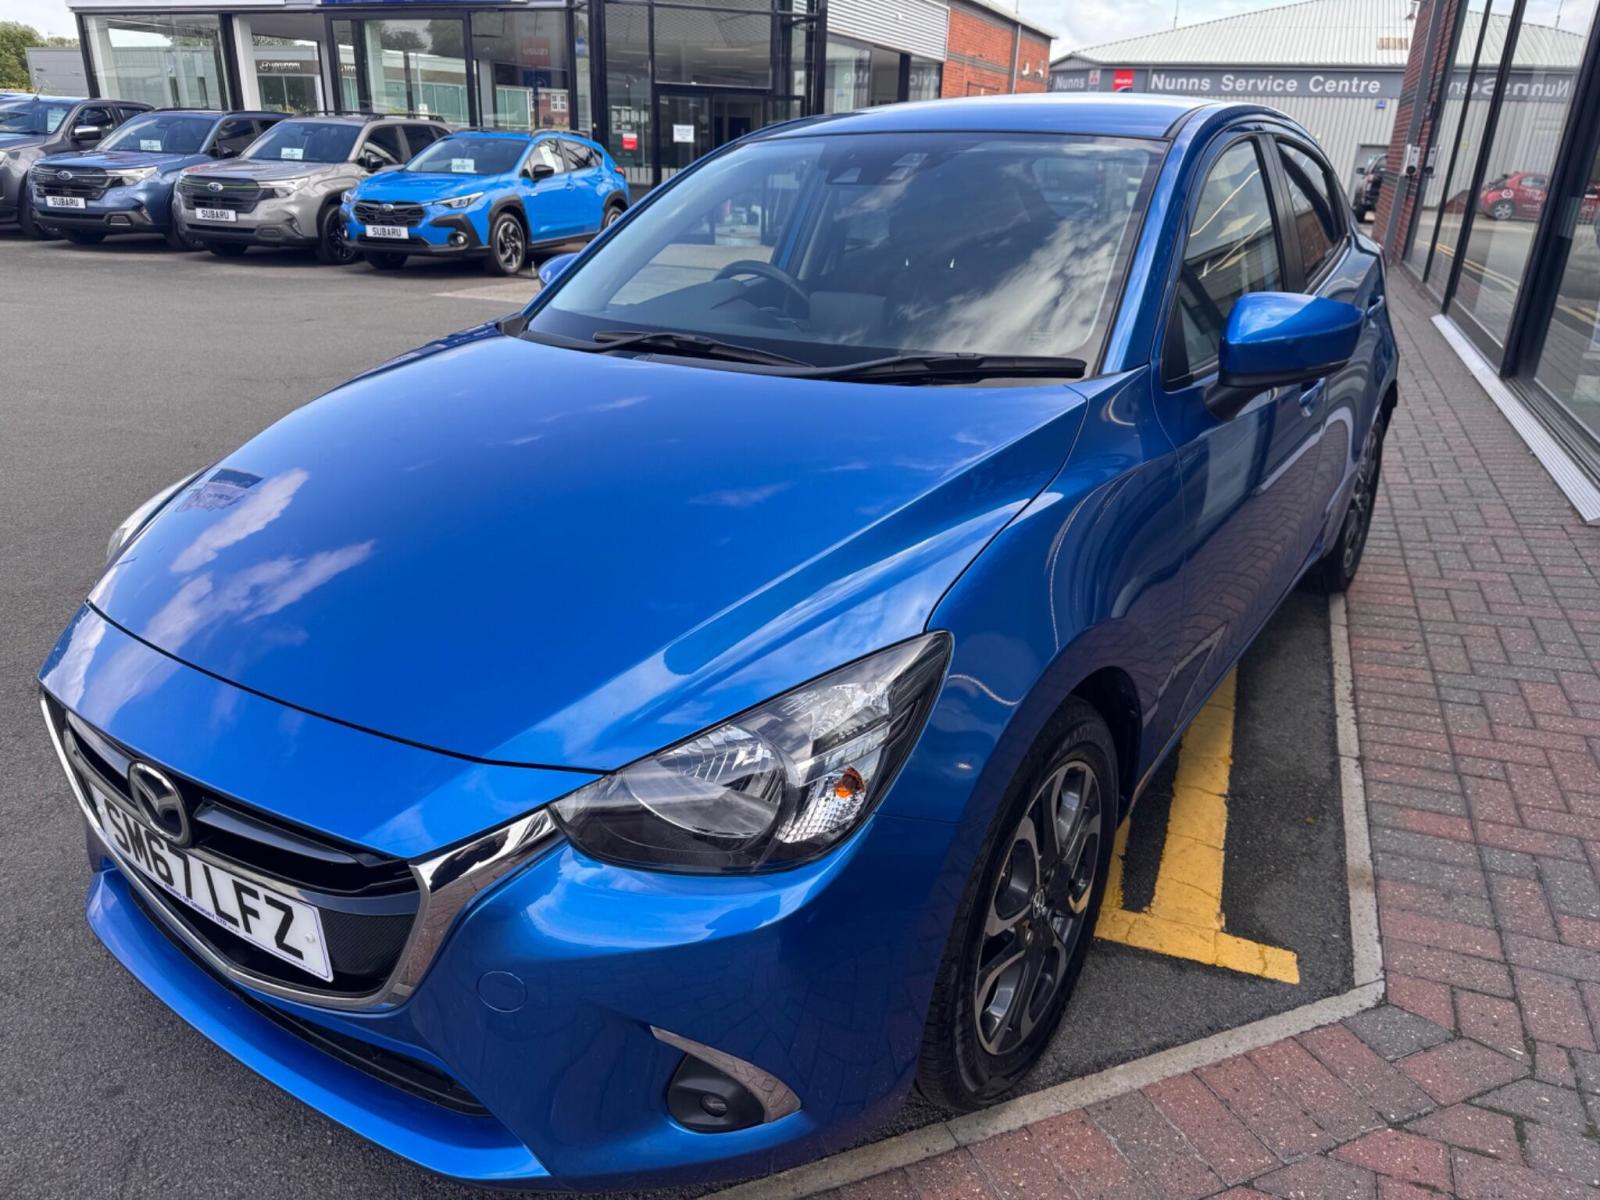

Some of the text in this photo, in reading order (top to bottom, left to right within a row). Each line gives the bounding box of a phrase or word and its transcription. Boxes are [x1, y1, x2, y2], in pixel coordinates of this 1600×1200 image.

[1055, 76, 1085, 90] Nunns
[1150, 74, 1381, 94] Nunns Service Centre
[51, 198, 80, 207] SUBARU
[201, 209, 230, 219] SUBARU
[371, 226, 402, 237] SUBARU
[104, 798, 304, 961] SM67 LFZ
